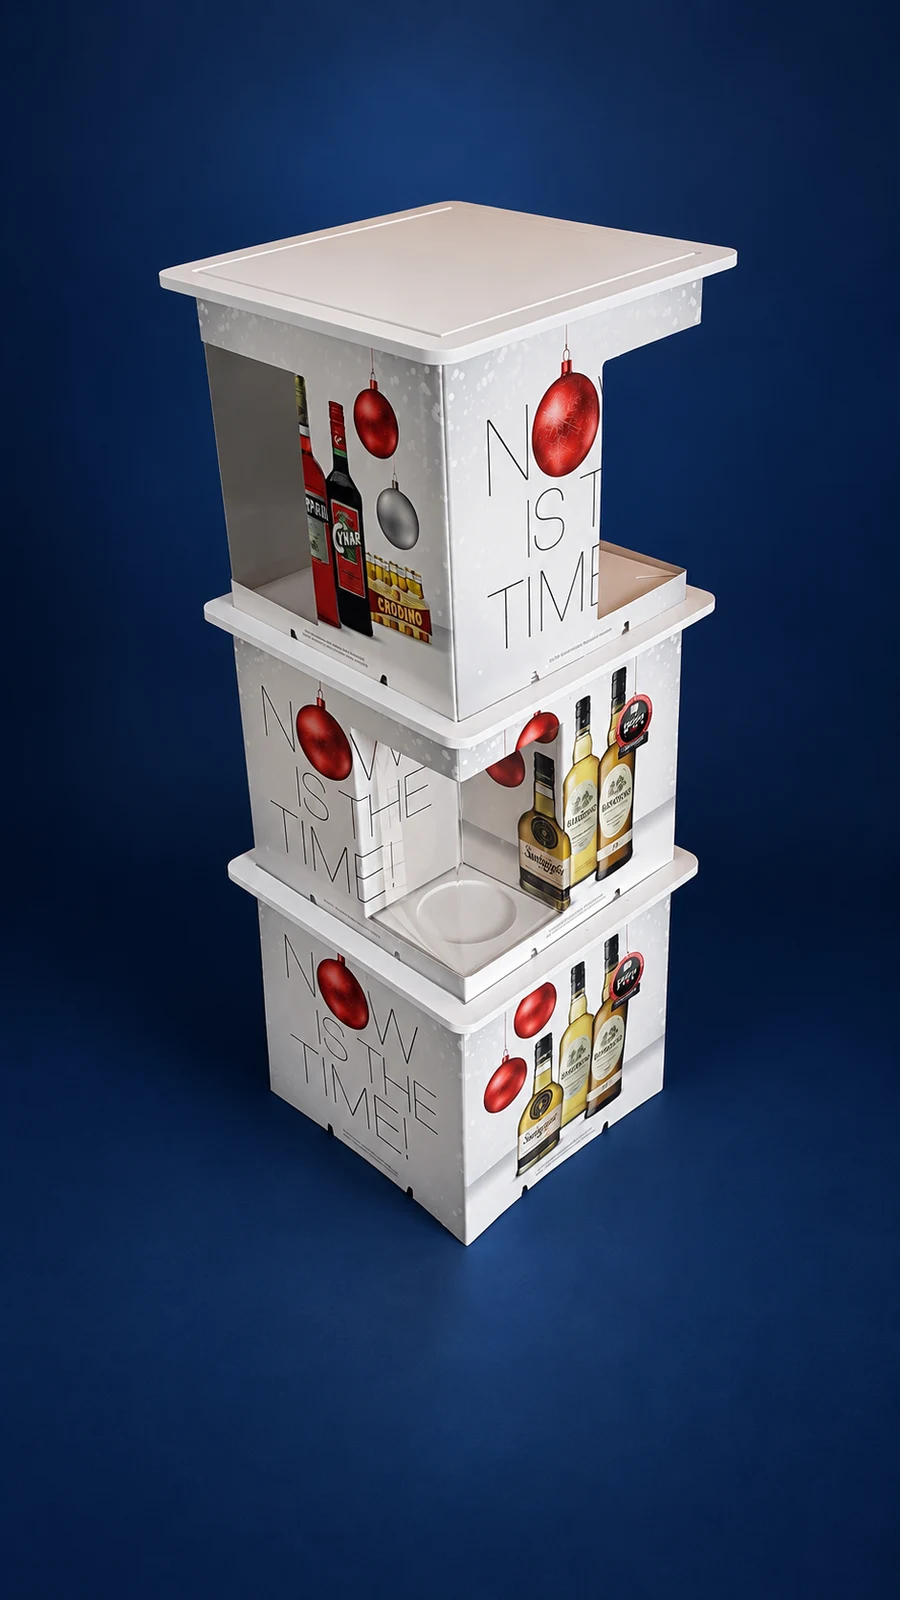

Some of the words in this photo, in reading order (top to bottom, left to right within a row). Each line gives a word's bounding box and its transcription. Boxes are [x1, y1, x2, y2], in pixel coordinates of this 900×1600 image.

[332, 522, 362, 554] CYNAR
[526, 487, 566, 559] IS
[377, 596, 423, 627] CRODINO
[295, 765, 330, 822] IS
[337, 765, 432, 841] THE
[289, 1033, 409, 1161] TIME!
[315, 1009, 349, 1062] IS
[356, 1037, 439, 1136] THE
